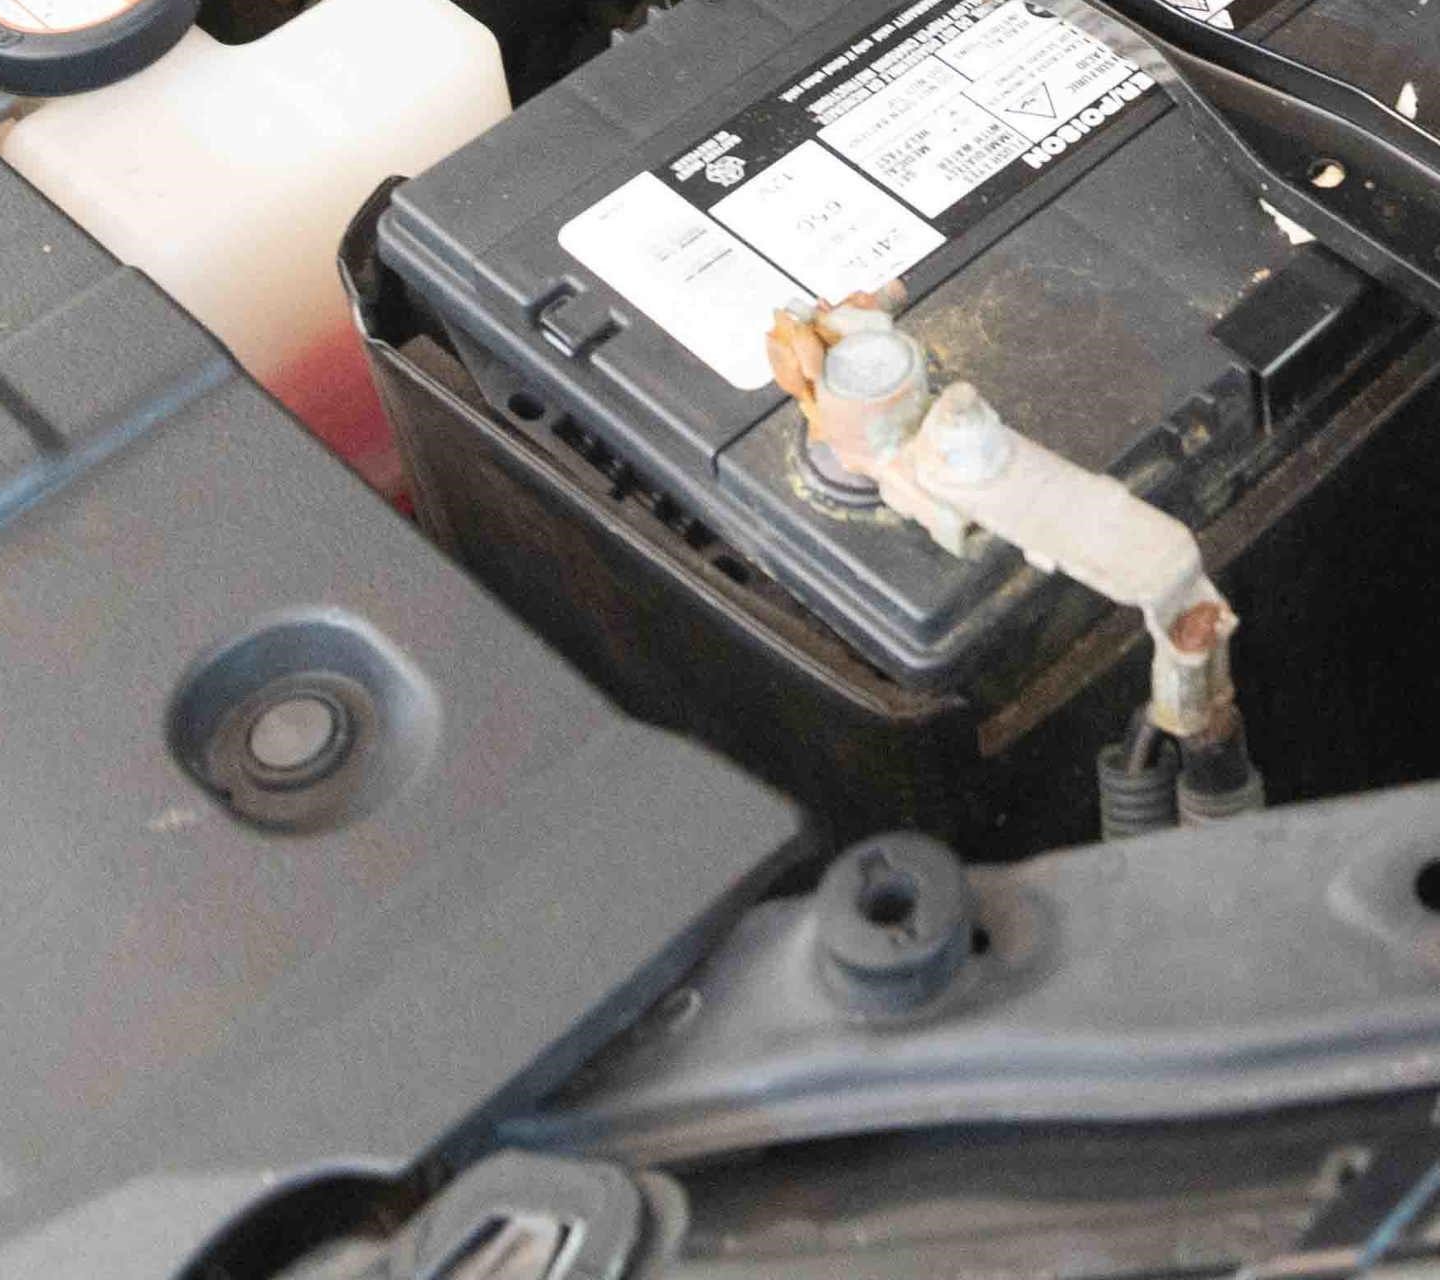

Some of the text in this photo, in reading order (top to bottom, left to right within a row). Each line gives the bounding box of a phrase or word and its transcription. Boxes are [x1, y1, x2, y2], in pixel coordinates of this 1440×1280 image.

[1063, 58, 1116, 94] SULFURIC
[1072, 50, 1102, 70] ACID
[880, 143, 932, 179] MEDICAL
[934, 142, 975, 170] WATER
[940, 130, 1015, 181] IMMEDIATELY
